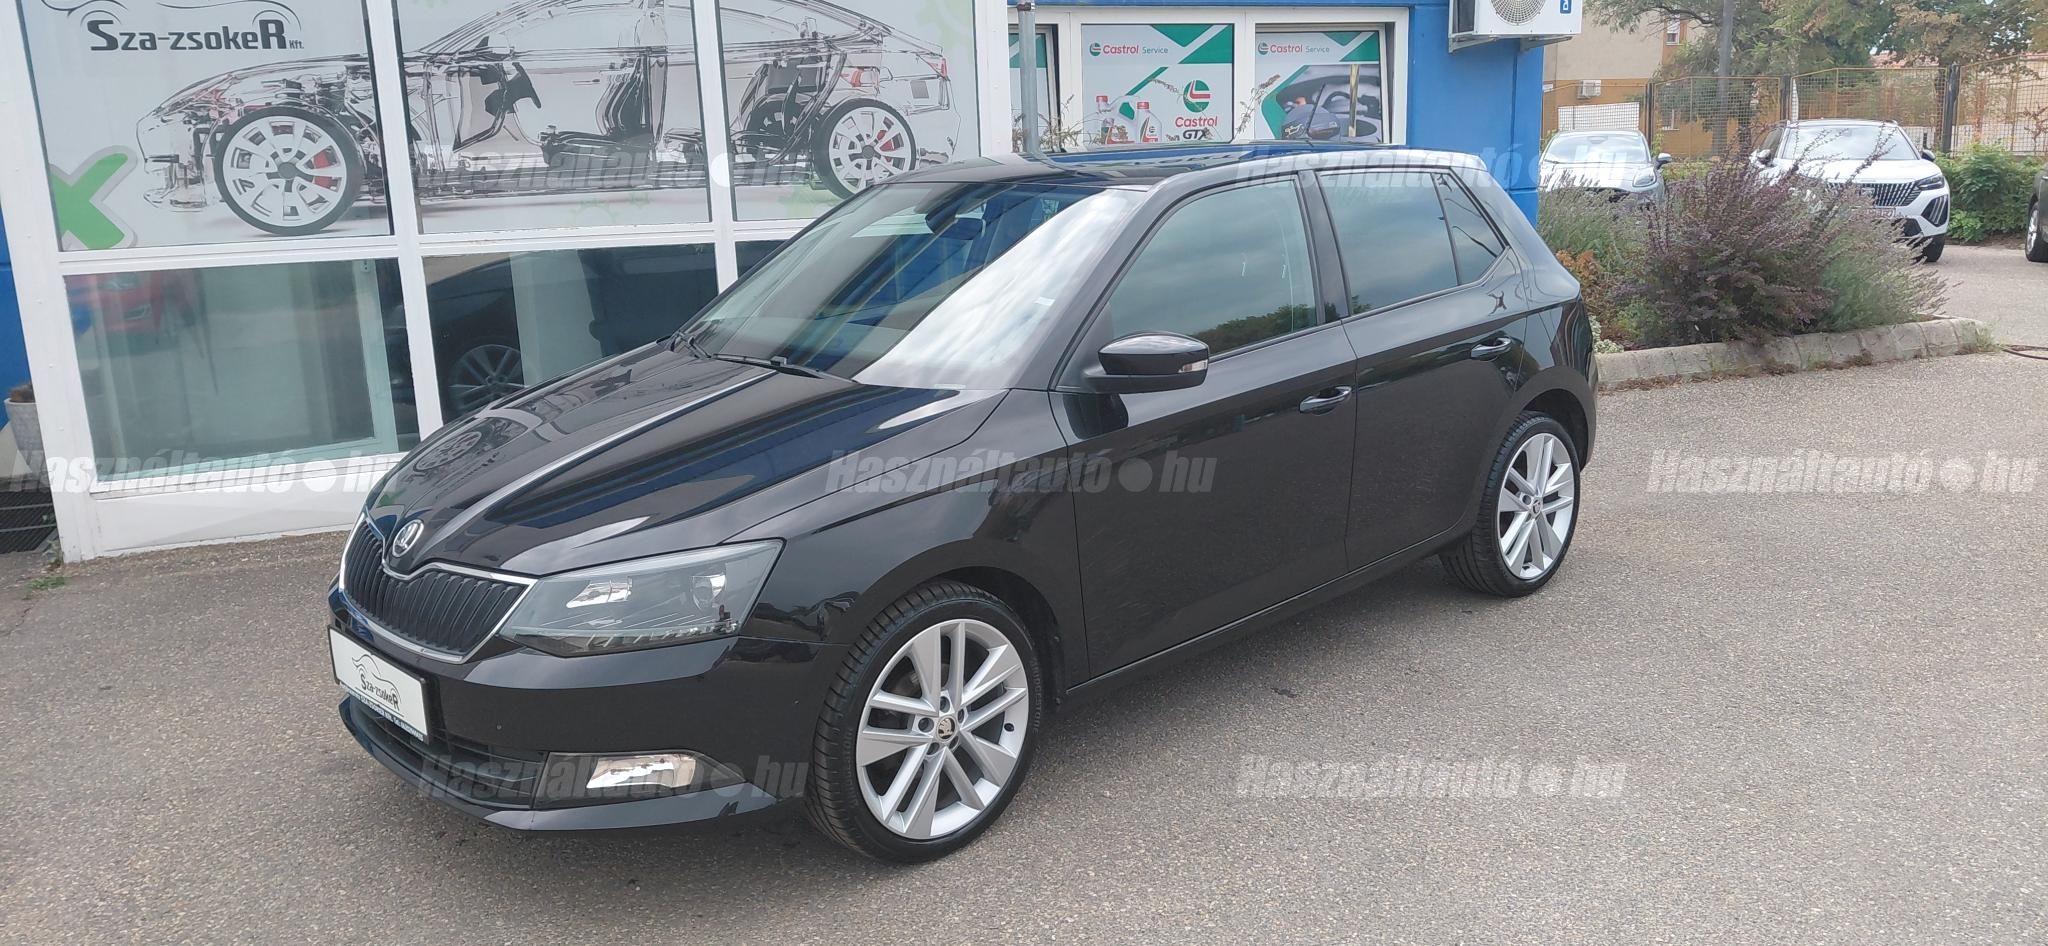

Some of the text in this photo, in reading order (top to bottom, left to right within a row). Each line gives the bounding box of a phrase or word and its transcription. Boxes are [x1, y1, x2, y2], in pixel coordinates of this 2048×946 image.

[87, 19, 305, 50] Sza-zsokeR Kft.
[1103, 44, 1169, 54] Castrol Service
[1270, 44, 1303, 53] Castrol
[1175, 116, 1218, 128] Castrol
[1183, 129, 1210, 140] GTX
